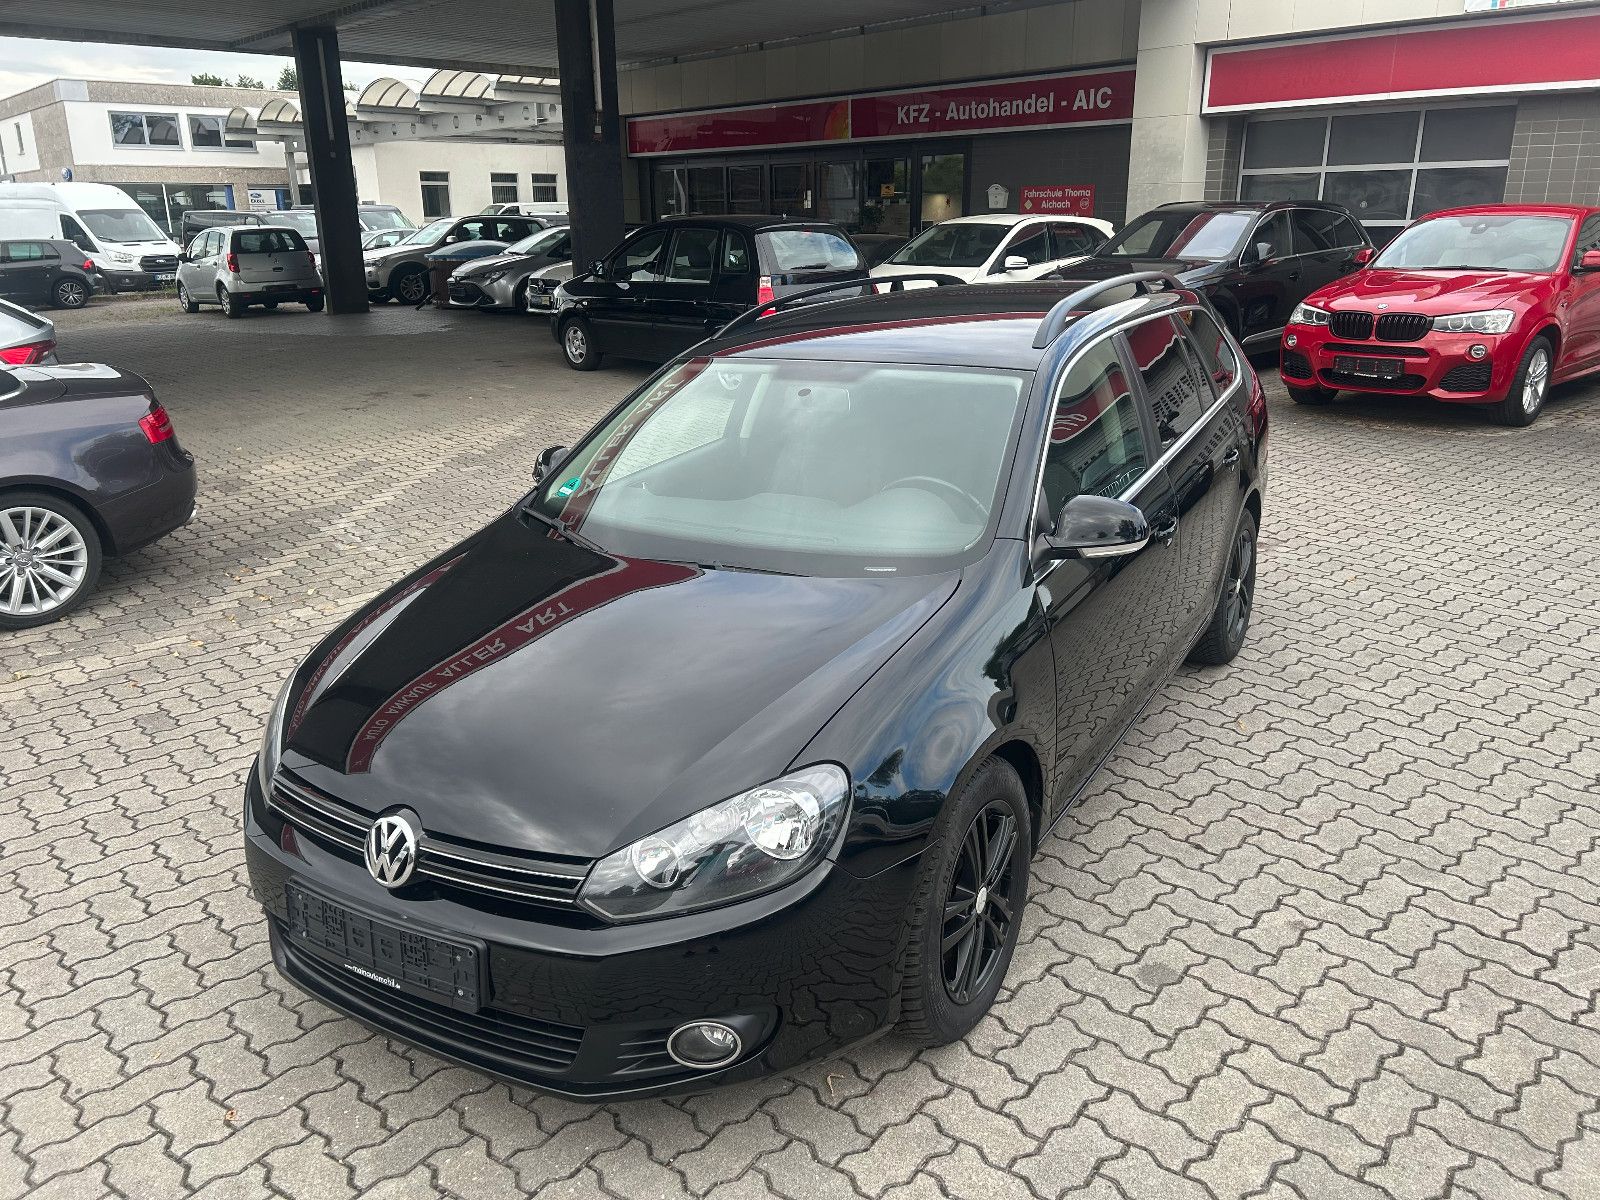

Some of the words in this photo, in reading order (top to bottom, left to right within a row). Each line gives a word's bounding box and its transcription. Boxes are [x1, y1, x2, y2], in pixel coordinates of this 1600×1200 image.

[897, 104, 929, 124] KFZ
[945, 92, 1054, 120] Autohandel
[1073, 87, 1112, 111] AIC
[1024, 189, 1063, 198] Fahrschule
[1065, 188, 1091, 198] Thoma
[1041, 199, 1071, 209] Aichach
